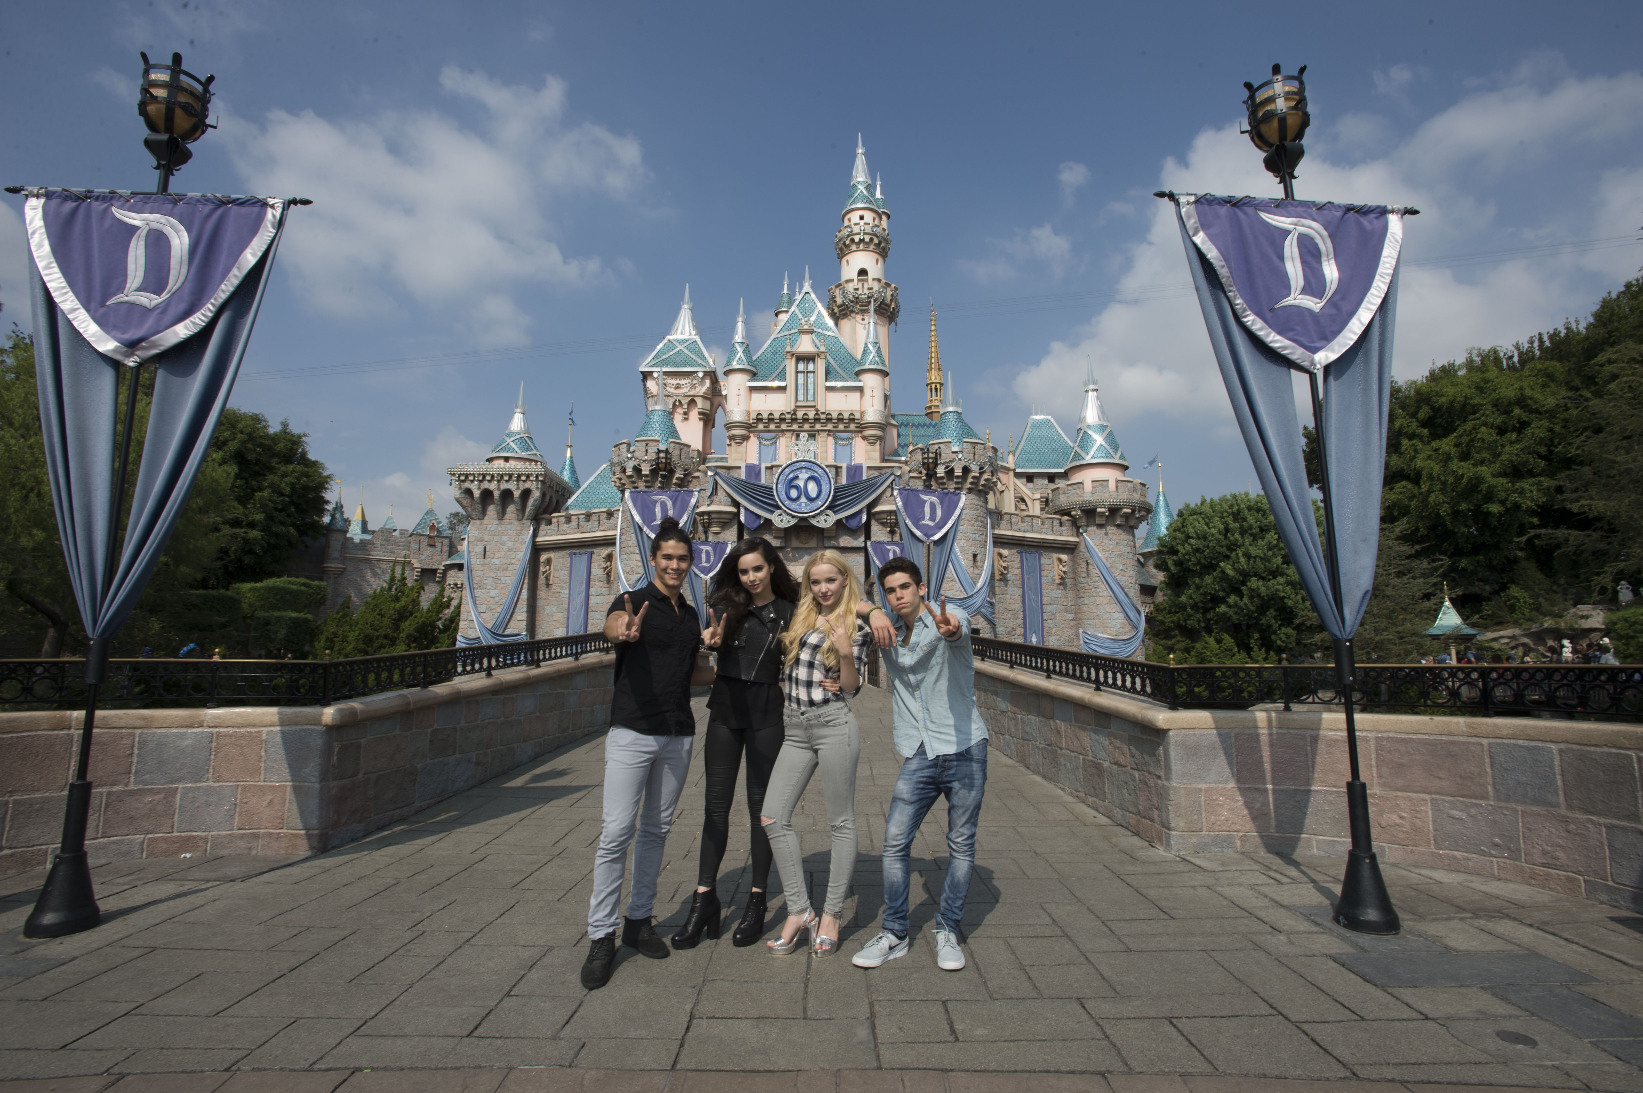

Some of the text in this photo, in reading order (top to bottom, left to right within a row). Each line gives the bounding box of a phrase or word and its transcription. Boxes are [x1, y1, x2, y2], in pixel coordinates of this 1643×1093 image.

[105, 205, 189, 310] D
[1256, 208, 1340, 313] D
[784, 474, 823, 502] 60
[918, 493, 942, 527] D
[696, 544, 715, 567] D
